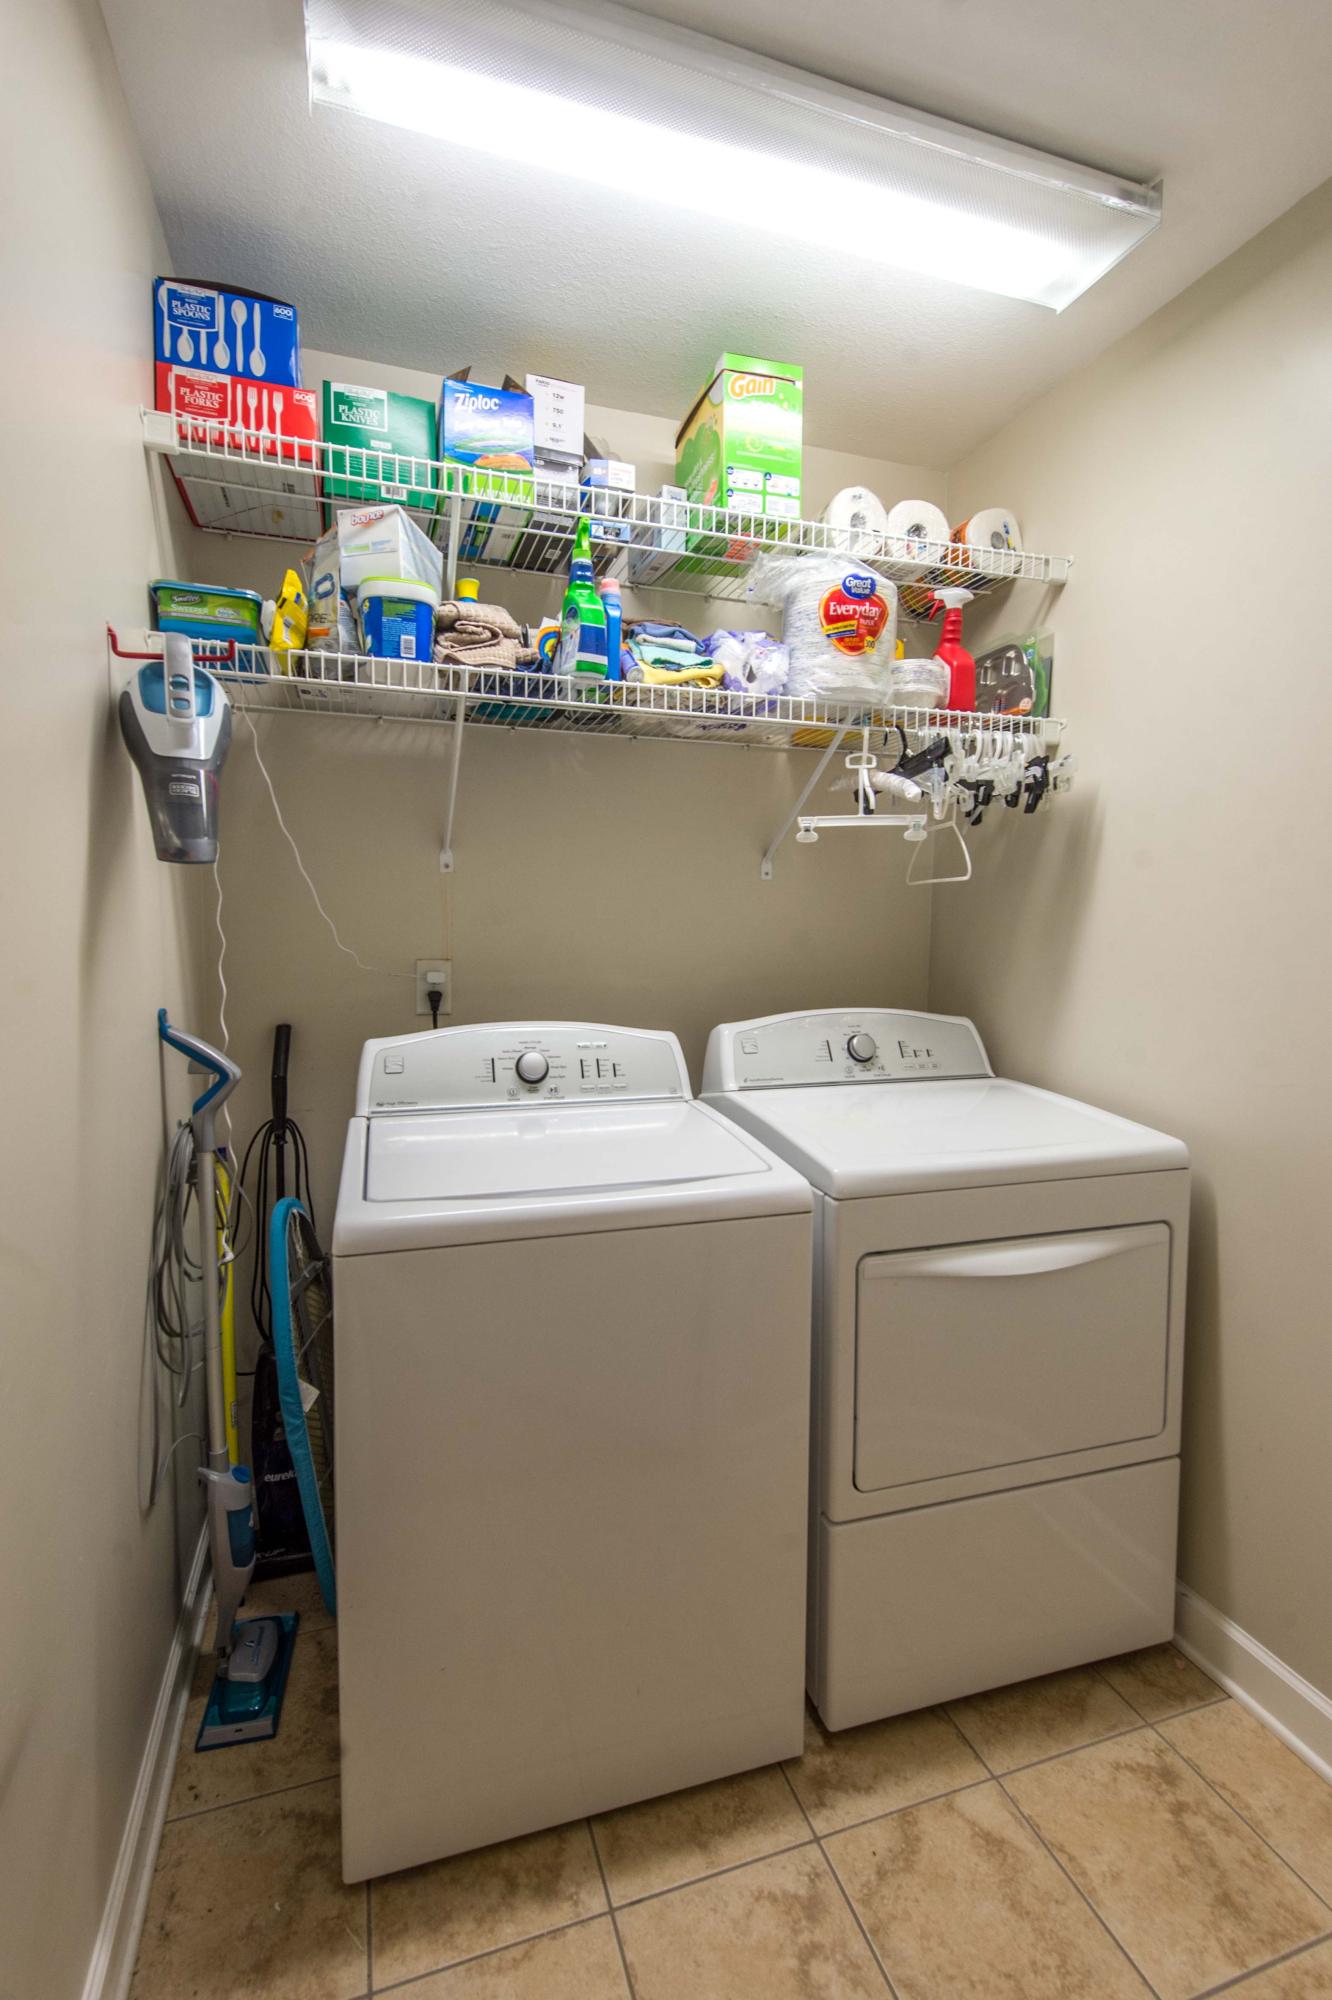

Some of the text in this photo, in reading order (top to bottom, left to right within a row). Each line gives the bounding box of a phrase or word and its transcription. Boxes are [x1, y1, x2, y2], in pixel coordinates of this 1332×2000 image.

[171, 299, 212, 313] PLASTIC
[172, 307, 210, 321] SPOONS
[729, 374, 776, 398] Gain
[180, 387, 223, 402] PLASTIC
[184, 396, 220, 409] FORKS
[454, 392, 500, 413] Ziploc
[338, 404, 380, 419] PLASTIC
[341, 412, 379, 426] KNIVES
[351, 510, 384, 526] bounce
[845, 576, 872, 588] Great
[829, 601, 882, 620] Everyday
[264, 1471, 298, 1482] eurek
